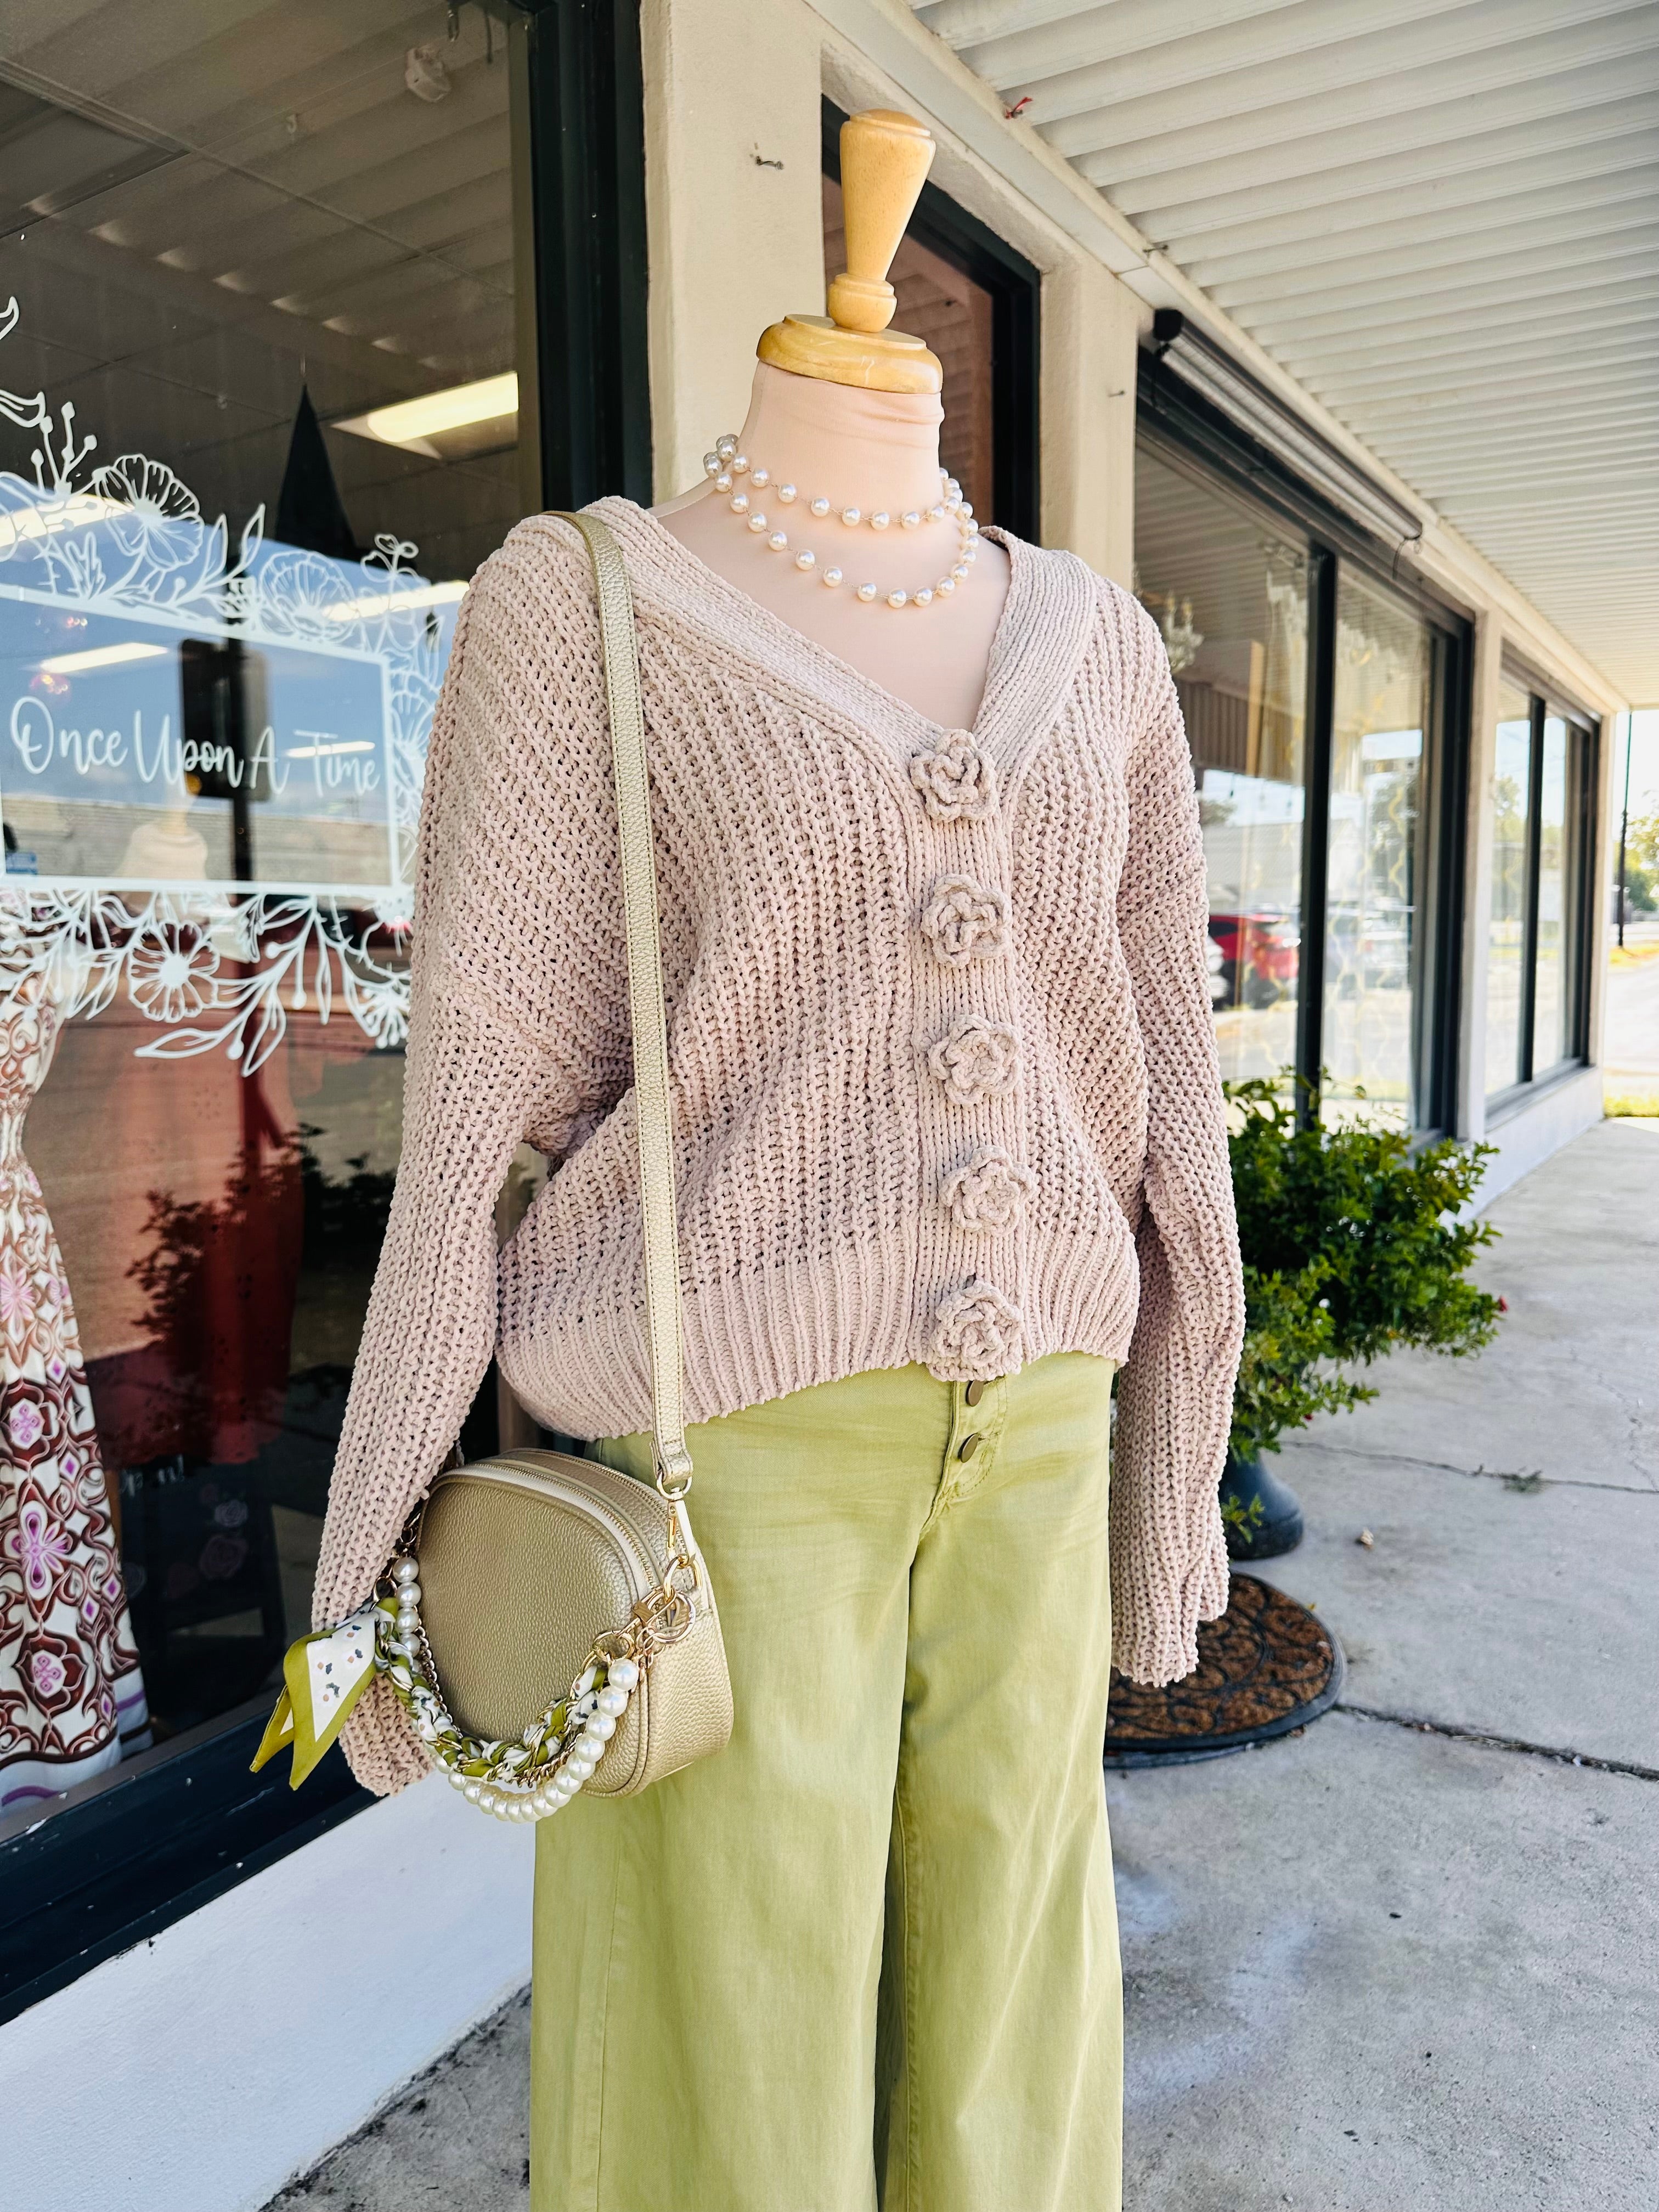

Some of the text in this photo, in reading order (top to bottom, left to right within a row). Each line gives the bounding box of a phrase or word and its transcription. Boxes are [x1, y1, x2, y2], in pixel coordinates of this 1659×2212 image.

[11, 696, 380, 797] Once Upon A Time
